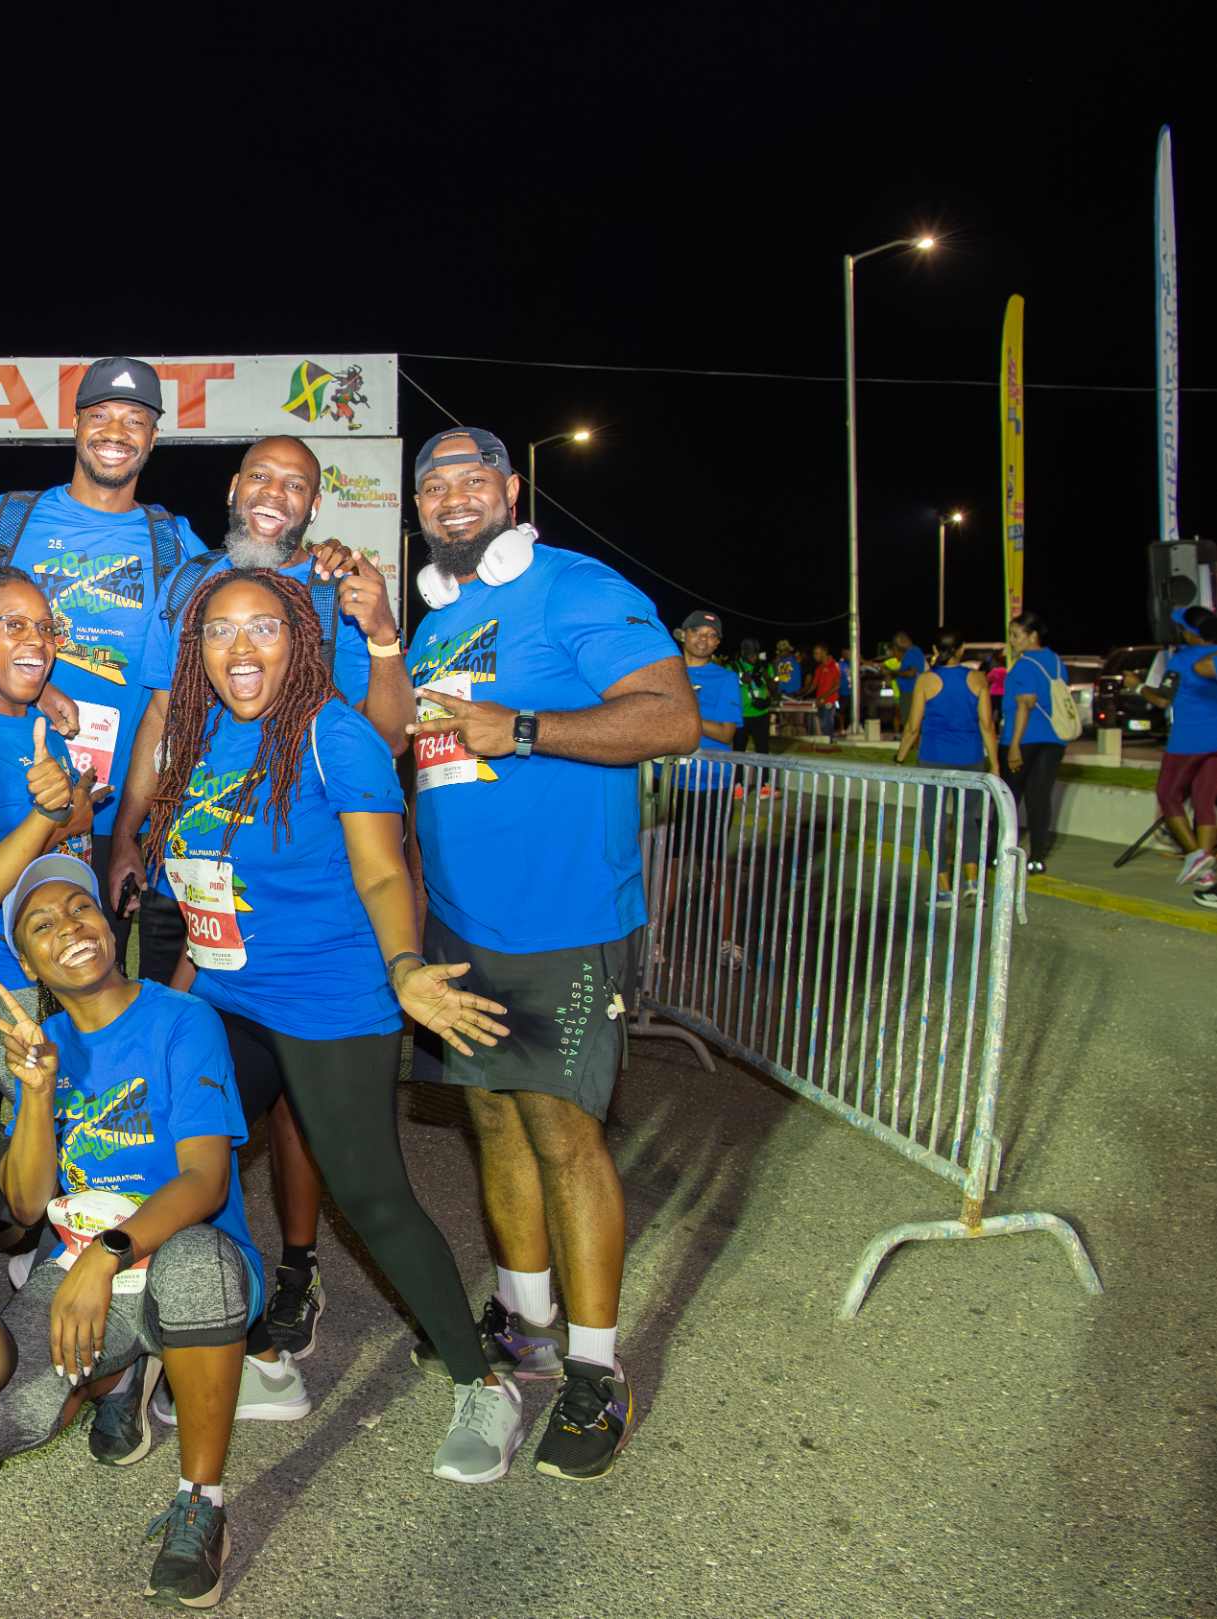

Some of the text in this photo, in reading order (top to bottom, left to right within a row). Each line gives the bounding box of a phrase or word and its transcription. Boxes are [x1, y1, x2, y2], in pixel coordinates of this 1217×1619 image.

[47, 538, 65, 550] 25.
[418, 731, 456, 761] 7344
[569, 981, 582, 1012] EST.
[554, 1007, 568, 1025] NY
[564, 963, 594, 1077] AEROPOSTALE
